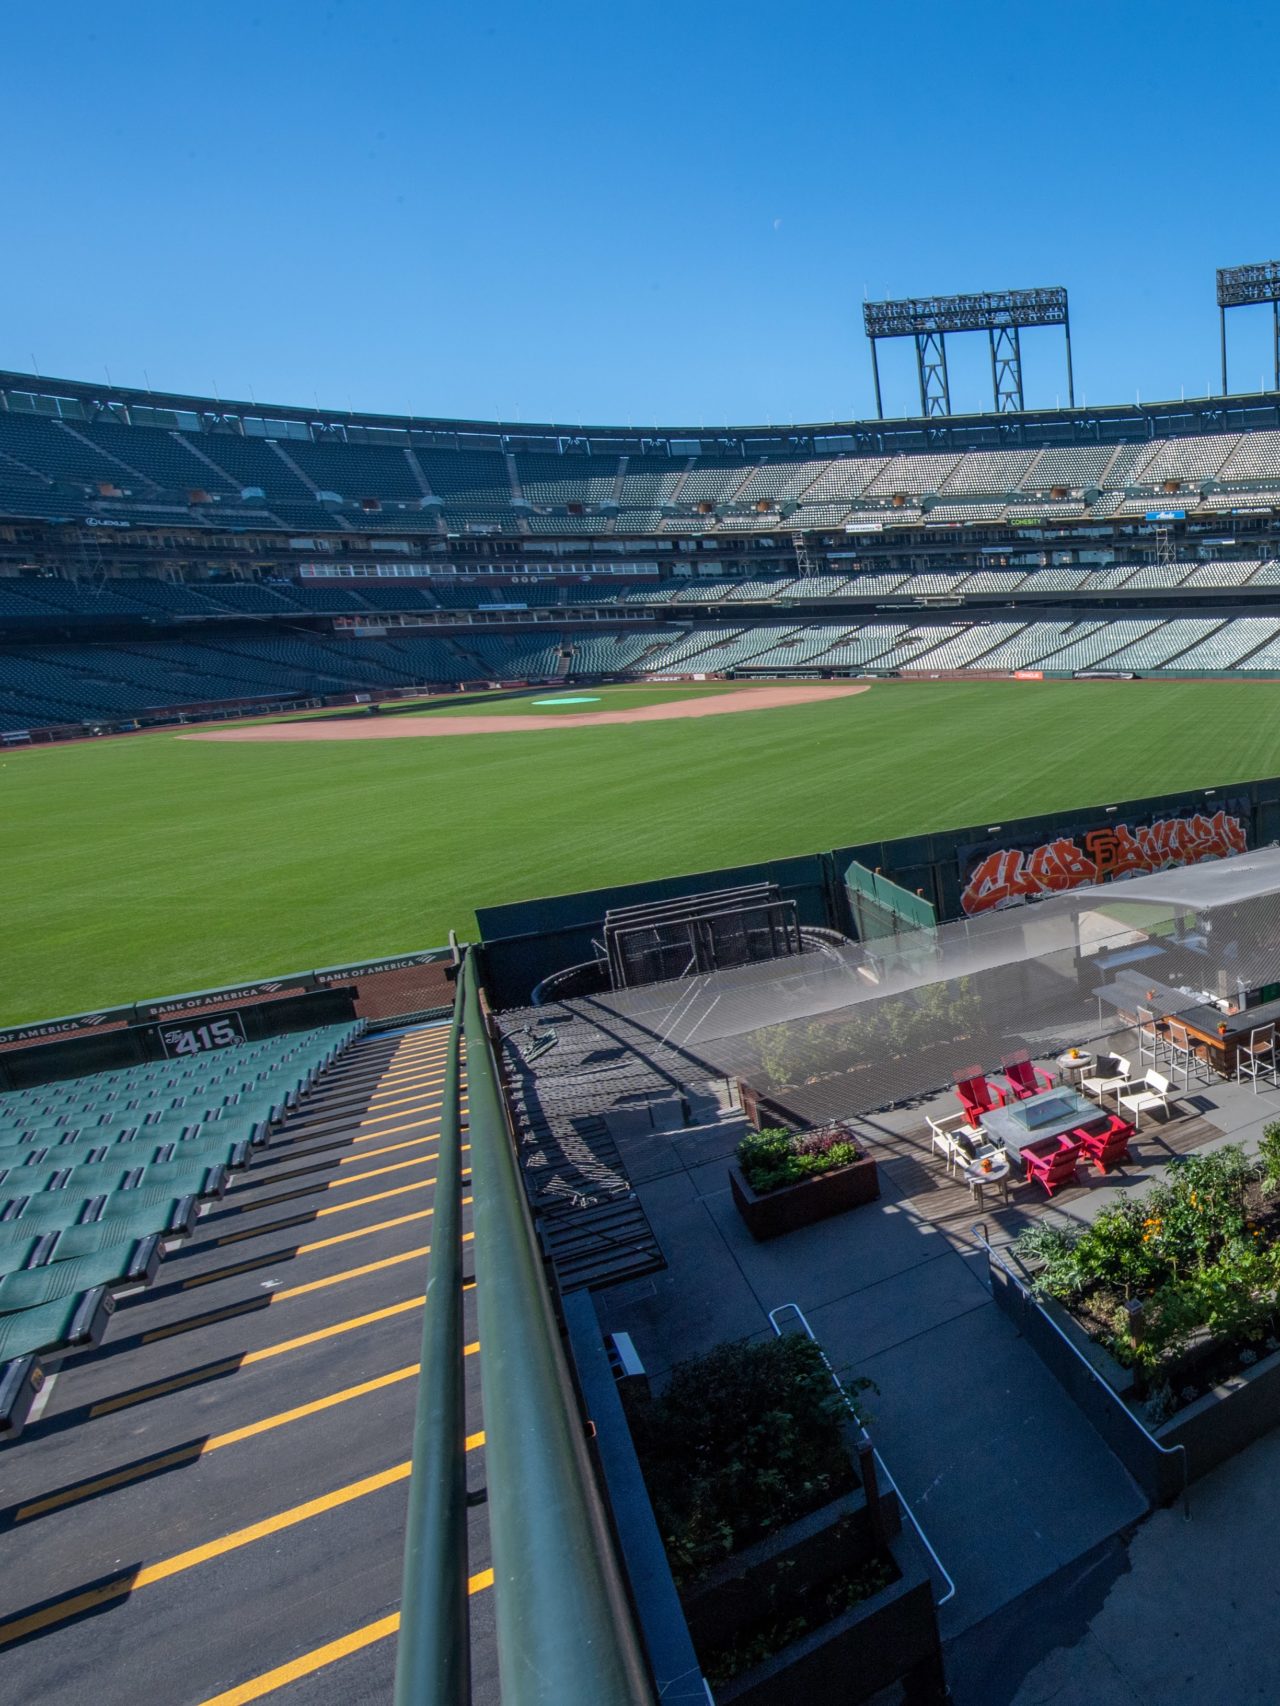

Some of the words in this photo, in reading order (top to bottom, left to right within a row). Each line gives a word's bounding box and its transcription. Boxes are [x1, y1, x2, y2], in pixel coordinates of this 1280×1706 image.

[1011, 518, 1042, 526] COHESITY
[318, 972, 350, 983] BANK
[351, 969, 365, 977] OF
[367, 960, 416, 975] AMERICA
[150, 1001, 184, 1015] BANK
[186, 999, 203, 1008] OF
[204, 989, 258, 1006] AMERICA
[0, 1033, 15, 1043] OF
[18, 1022, 80, 1040] AMERICA
[175, 1019, 235, 1054] 415
